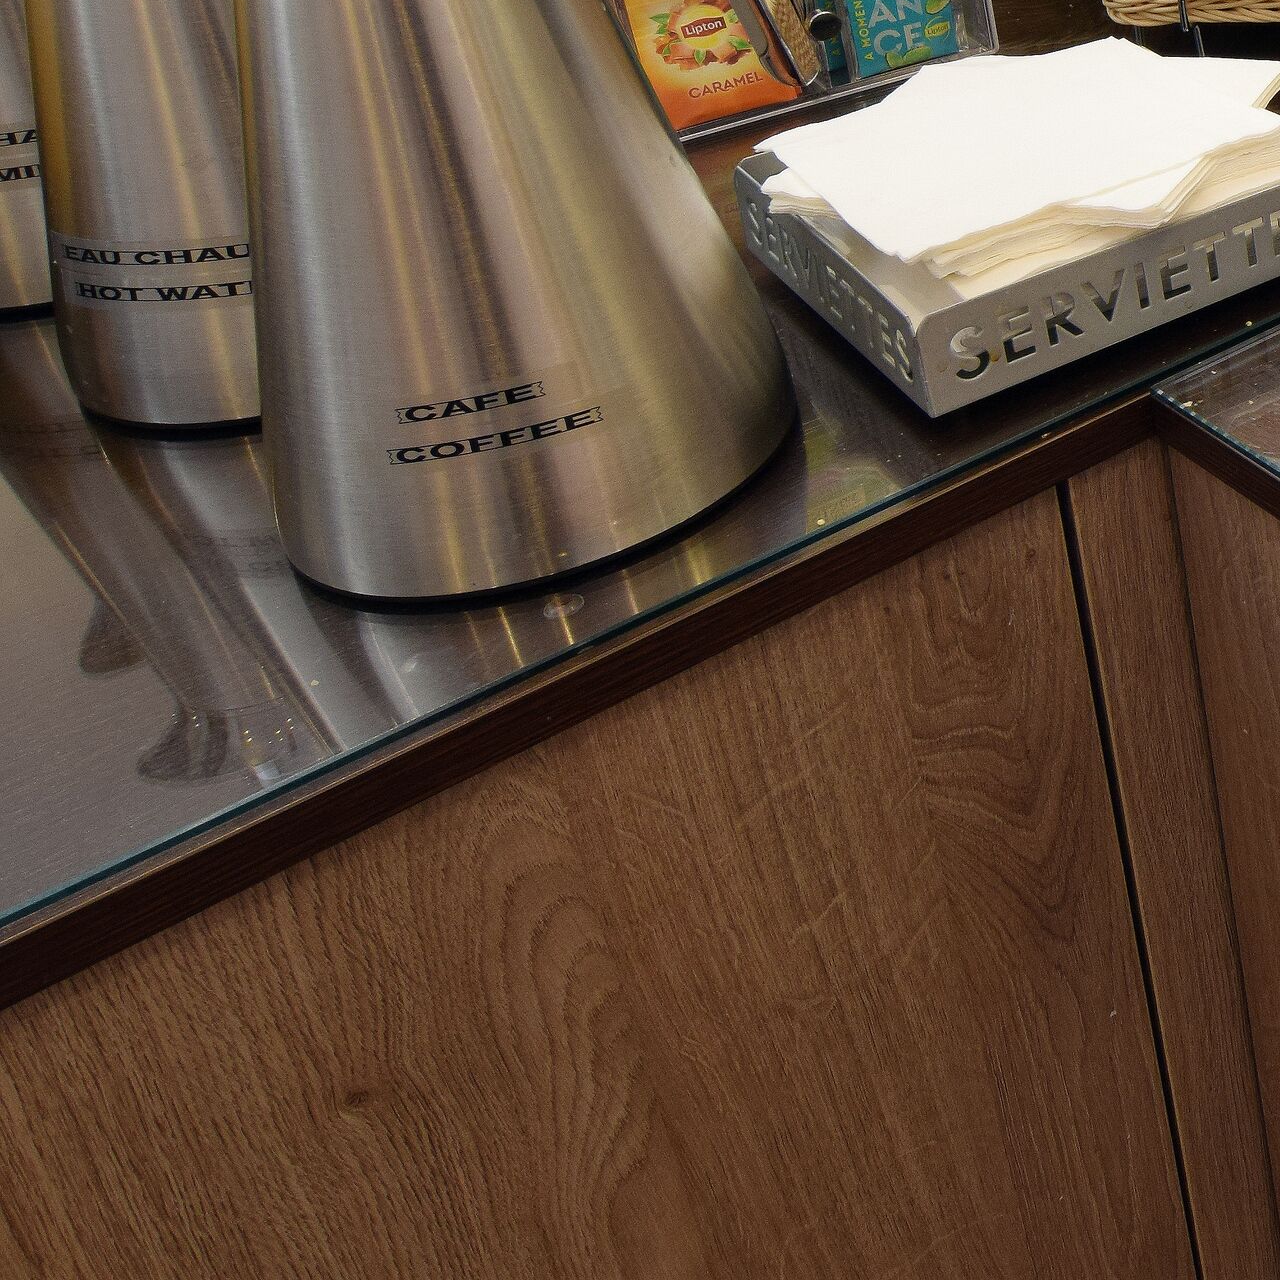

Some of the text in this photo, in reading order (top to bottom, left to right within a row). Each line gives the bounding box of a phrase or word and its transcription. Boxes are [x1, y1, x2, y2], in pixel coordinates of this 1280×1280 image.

[684, 19, 724, 36] Lipton
[873, 21, 926, 57] CE
[926, 22, 949, 36] Lipton
[688, 71, 764, 100] CARAMEL
[65, 243, 249, 265] EAU CHAU
[79, 280, 252, 301] HOT WAT
[748, 202, 914, 383] SERVIETTES
[404, 383, 538, 422] CAFE
[396, 411, 597, 463] COFFEE
